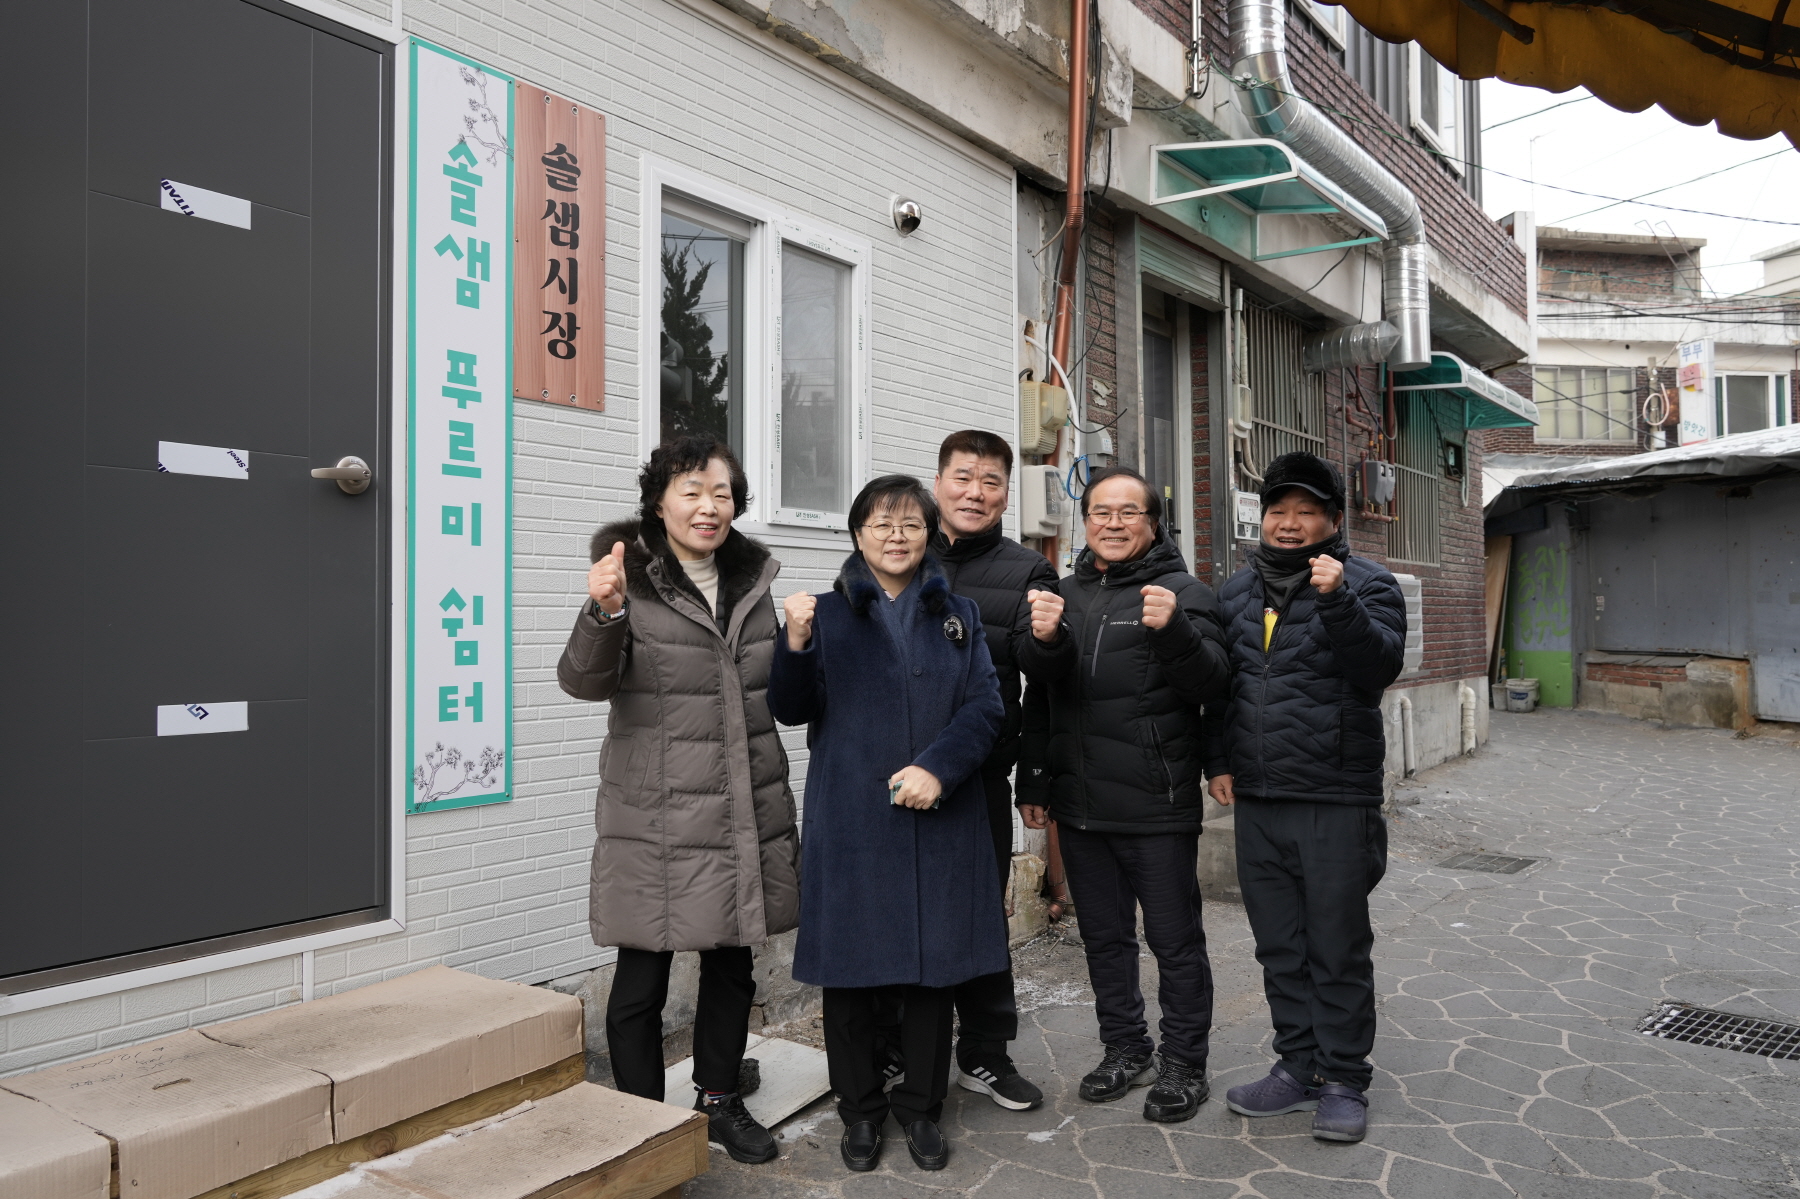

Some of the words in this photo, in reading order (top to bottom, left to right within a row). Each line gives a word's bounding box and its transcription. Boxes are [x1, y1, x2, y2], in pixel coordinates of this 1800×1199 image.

[433, 142, 490, 309] 솔샘
[540, 143, 581, 360] 솔샘시장
[1682, 342, 1703, 362] 부부
[441, 349, 482, 546] 푸르미
[1683, 419, 1706, 437] 방앗간
[438, 587, 484, 722] 쉼터
